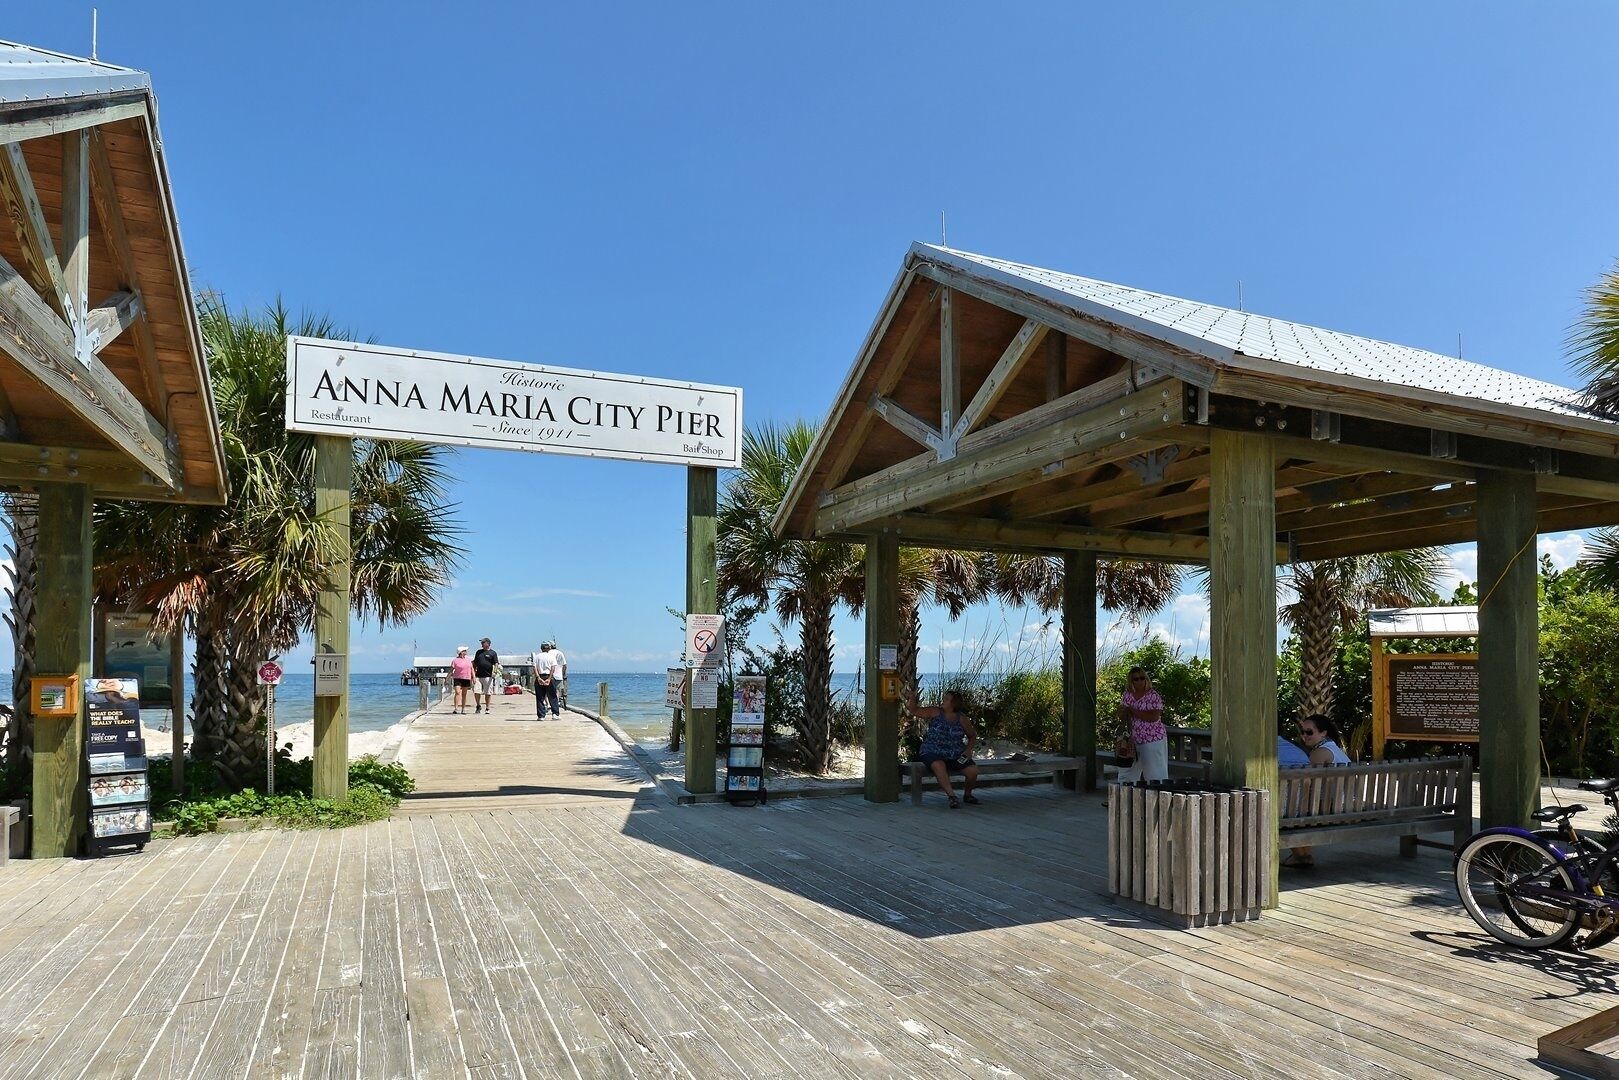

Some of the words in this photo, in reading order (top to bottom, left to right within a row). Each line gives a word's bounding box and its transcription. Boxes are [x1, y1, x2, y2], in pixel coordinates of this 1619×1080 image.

[499, 370, 566, 391] Historic
[310, 369, 429, 410] ANNA
[438, 381, 558, 422] MARIA
[566, 396, 646, 430] CITY
[655, 404, 725, 438] PIER
[310, 408, 372, 424] Restaurant
[491, 420, 532, 436] Since
[537, 427, 573, 441] 1911
[683, 443, 699, 454] Bait
[701, 445, 724, 457] Shop
